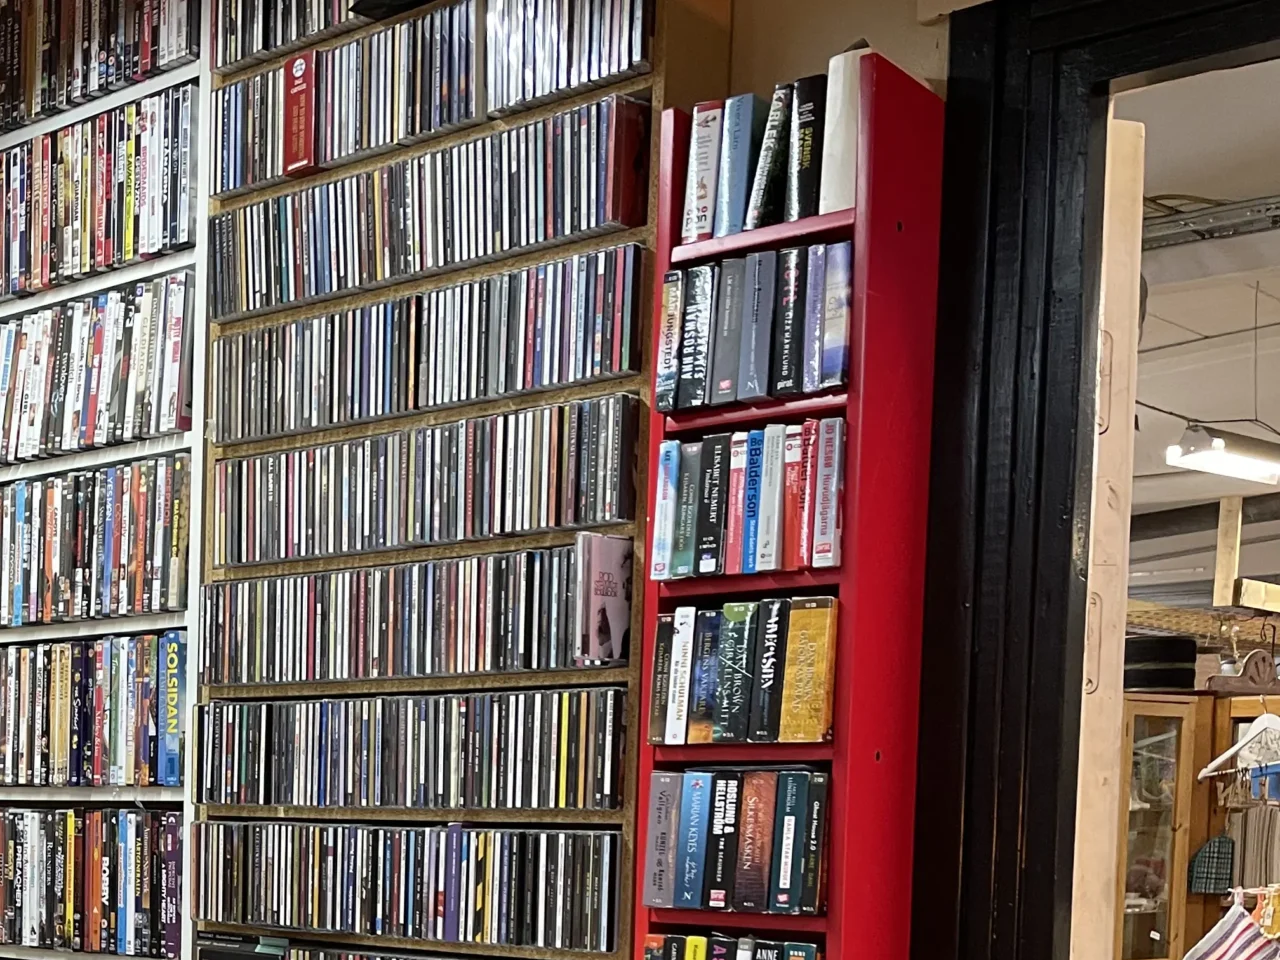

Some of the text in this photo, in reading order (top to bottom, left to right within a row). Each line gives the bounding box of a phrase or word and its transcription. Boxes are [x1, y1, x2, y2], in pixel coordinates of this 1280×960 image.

[709, 445, 721, 523] ELISABET NEMERT
[747, 448, 762, 518] Balderson
[167, 643, 179, 733] SOLSIDAN
[676, 673, 686, 720] SCHULMAN
[732, 673, 744, 712] BROWN
[804, 642, 817, 700] DAN BROWN
[686, 791, 703, 853] MARIAN KEYES
[713, 780, 727, 834] HELLSTRÖM
[723, 780, 738, 823] ROSLUND
[743, 796, 758, 870] SILKESMASKEN
